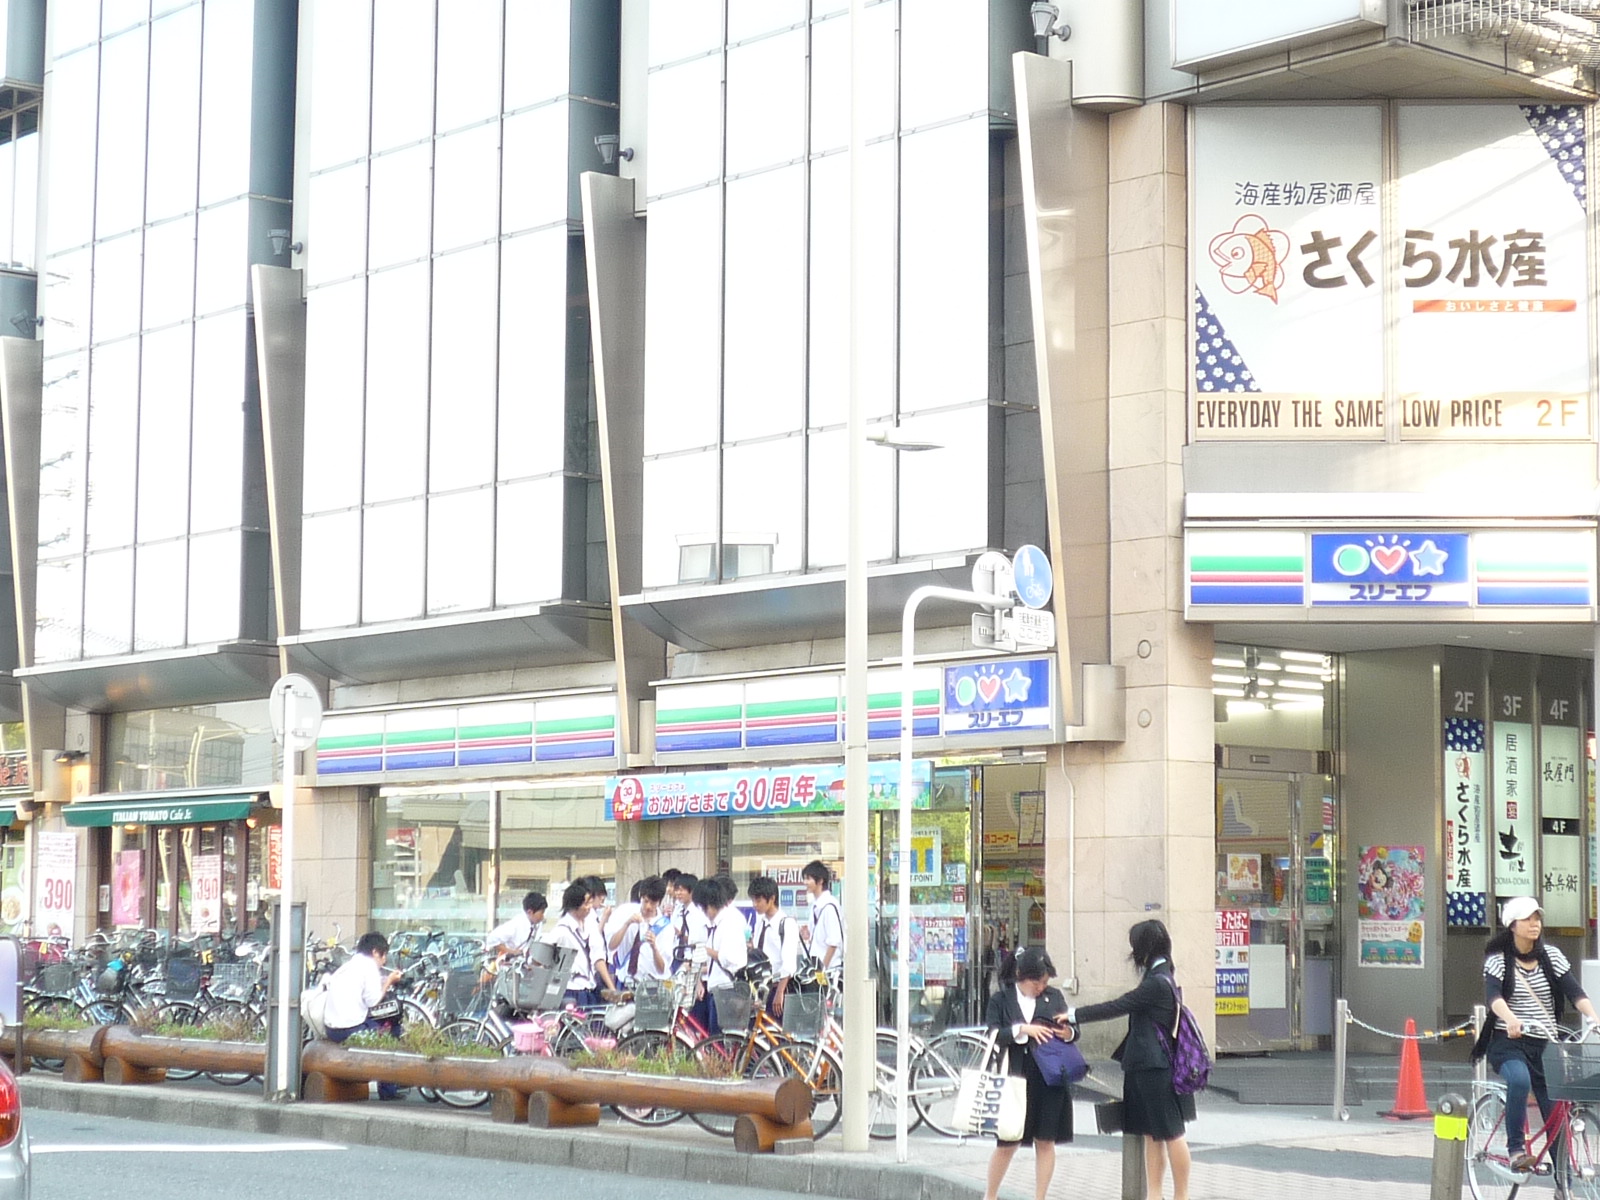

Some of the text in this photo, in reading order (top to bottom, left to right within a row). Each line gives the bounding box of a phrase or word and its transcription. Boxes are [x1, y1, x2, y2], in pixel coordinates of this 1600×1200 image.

[1234, 180, 1376, 206] 海産物居酒屋
[1300, 228, 1548, 288] さくら水産
[1197, 399, 1281, 428] EVERYDAY
[1292, 400, 1322, 427] THE
[1335, 400, 1384, 427] SAME
[1402, 399, 1440, 427] LOW
[1451, 399, 1502, 427] PRICE
[1349, 583, 1433, 601] スリーエフ
[1454, 691, 1475, 713] 2F
[1503, 695, 1522, 716] 3F
[1549, 700, 1569, 720] 4F
[968, 710, 1024, 729] スリーエフ
[648, 775, 816, 815] おかげさまで 30周年
[112, 811, 138, 822] ITALIAN
[139, 810, 168, 822] TOMATO
[1552, 820, 1566, 834] 4F
[1456, 782, 1472, 888] さくら水産
[44, 878, 72, 910] 390
[197, 877, 219, 900] 390
